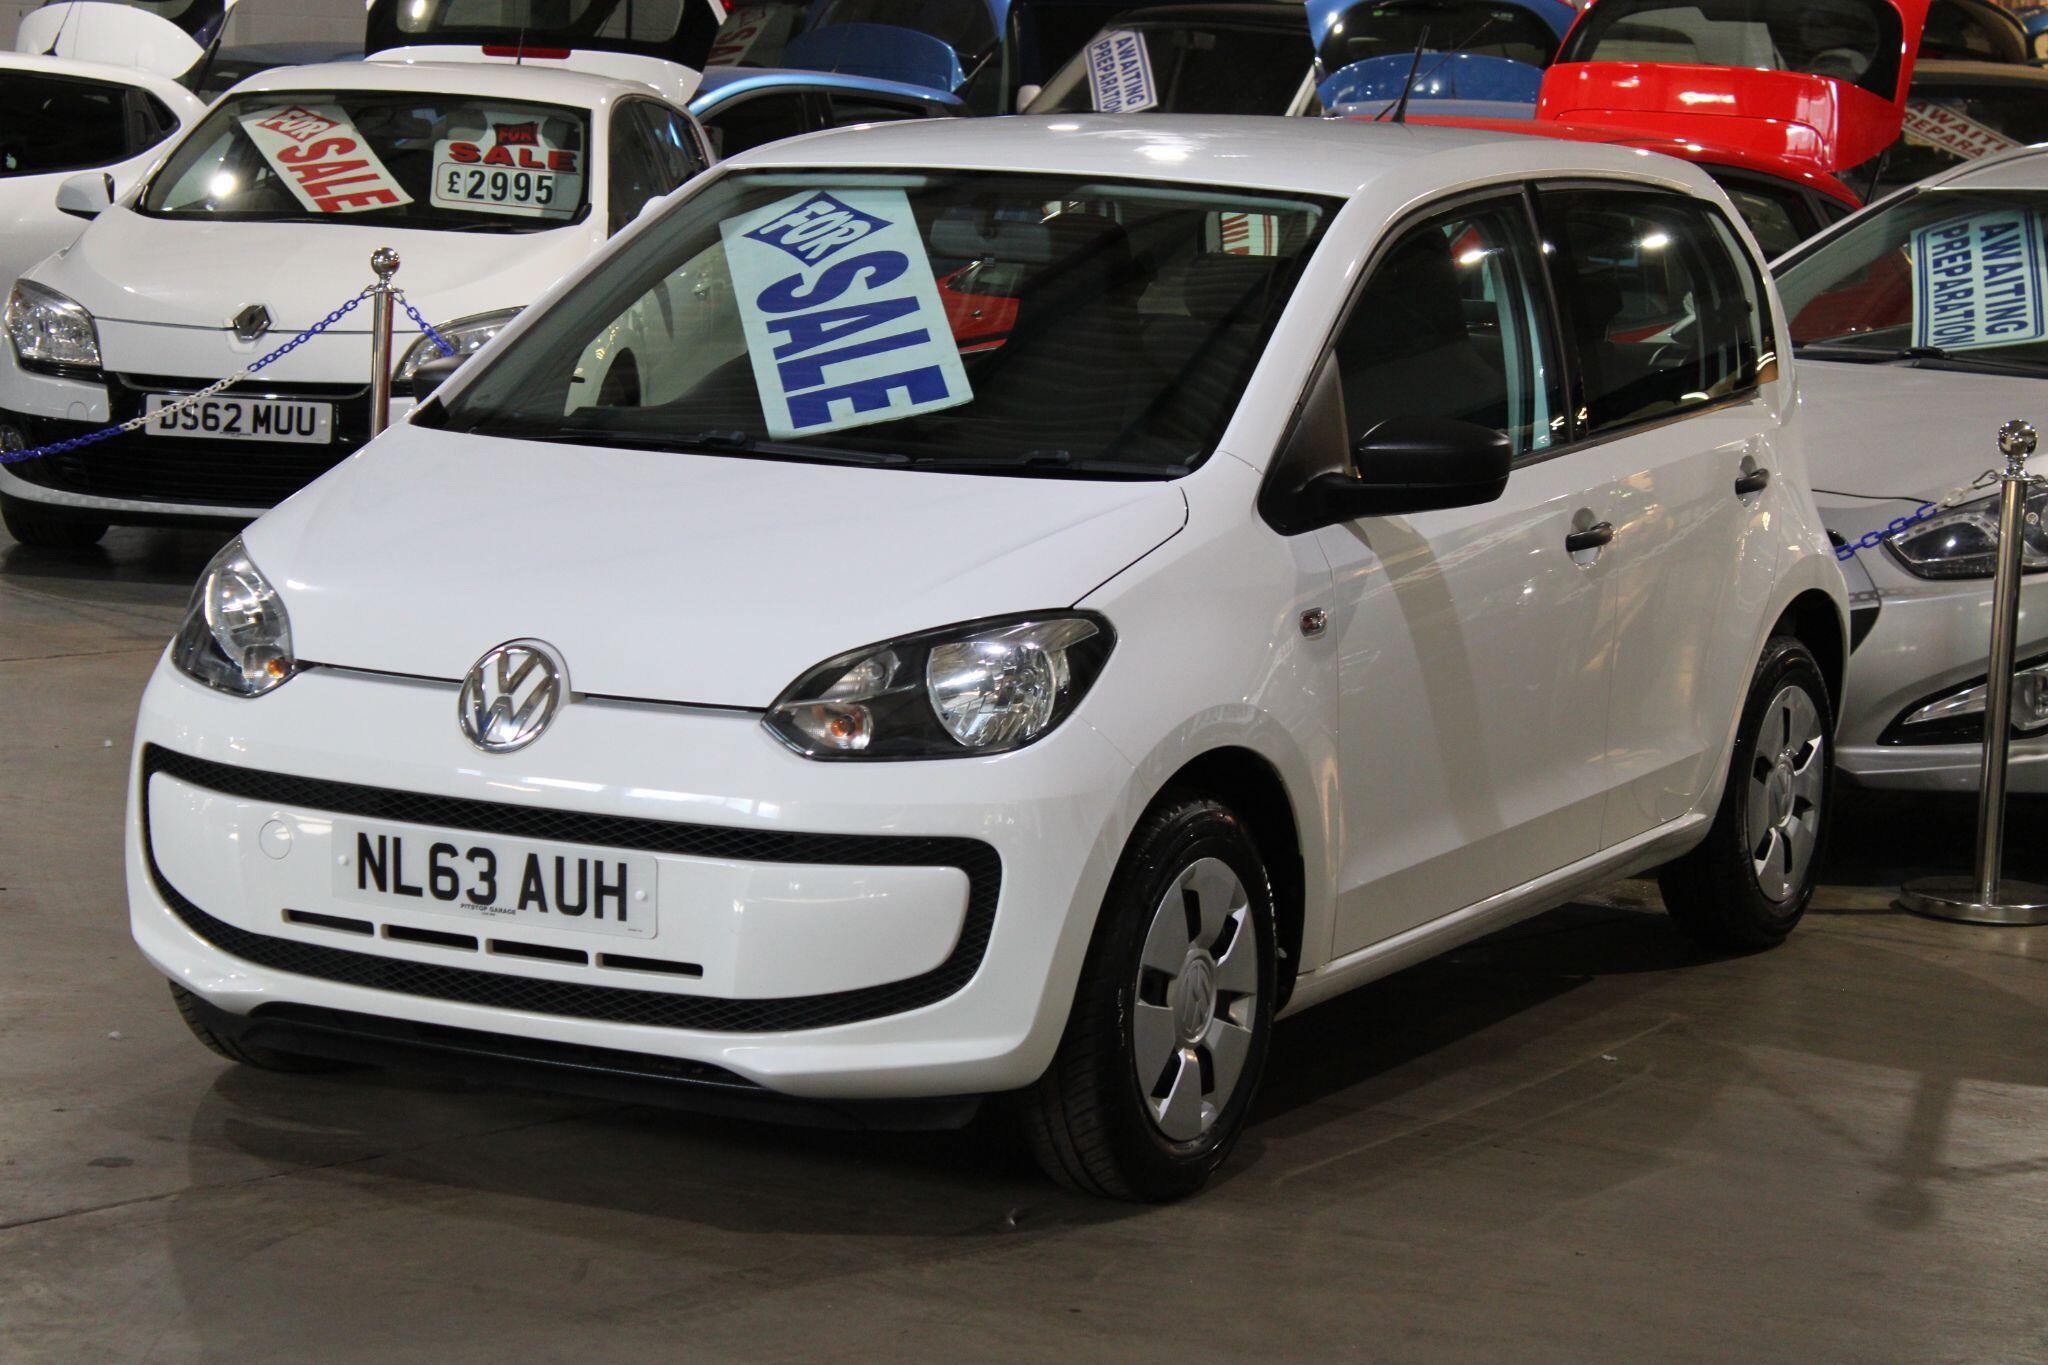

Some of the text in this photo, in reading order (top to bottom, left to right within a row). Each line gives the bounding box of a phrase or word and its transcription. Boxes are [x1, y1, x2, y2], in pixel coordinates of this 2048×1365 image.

[1115, 36, 1145, 105] AWAITING
[264, 110, 329, 142] FOR
[499, 125, 533, 143] FOR
[277, 137, 400, 212] SALE
[447, 170, 554, 204] £2995
[448, 142, 577, 172] SALE
[759, 200, 872, 260] FOR
[1931, 222, 1976, 347] PREPARATION
[1979, 221, 2029, 336] AWAITING
[756, 250, 950, 430] SALE
[160, 400, 316, 436] DS62 MUU
[357, 832, 628, 922] NL63 AUH
[460, 902, 488, 911] PITSTOP
[489, 906, 516, 915] GARAGE
